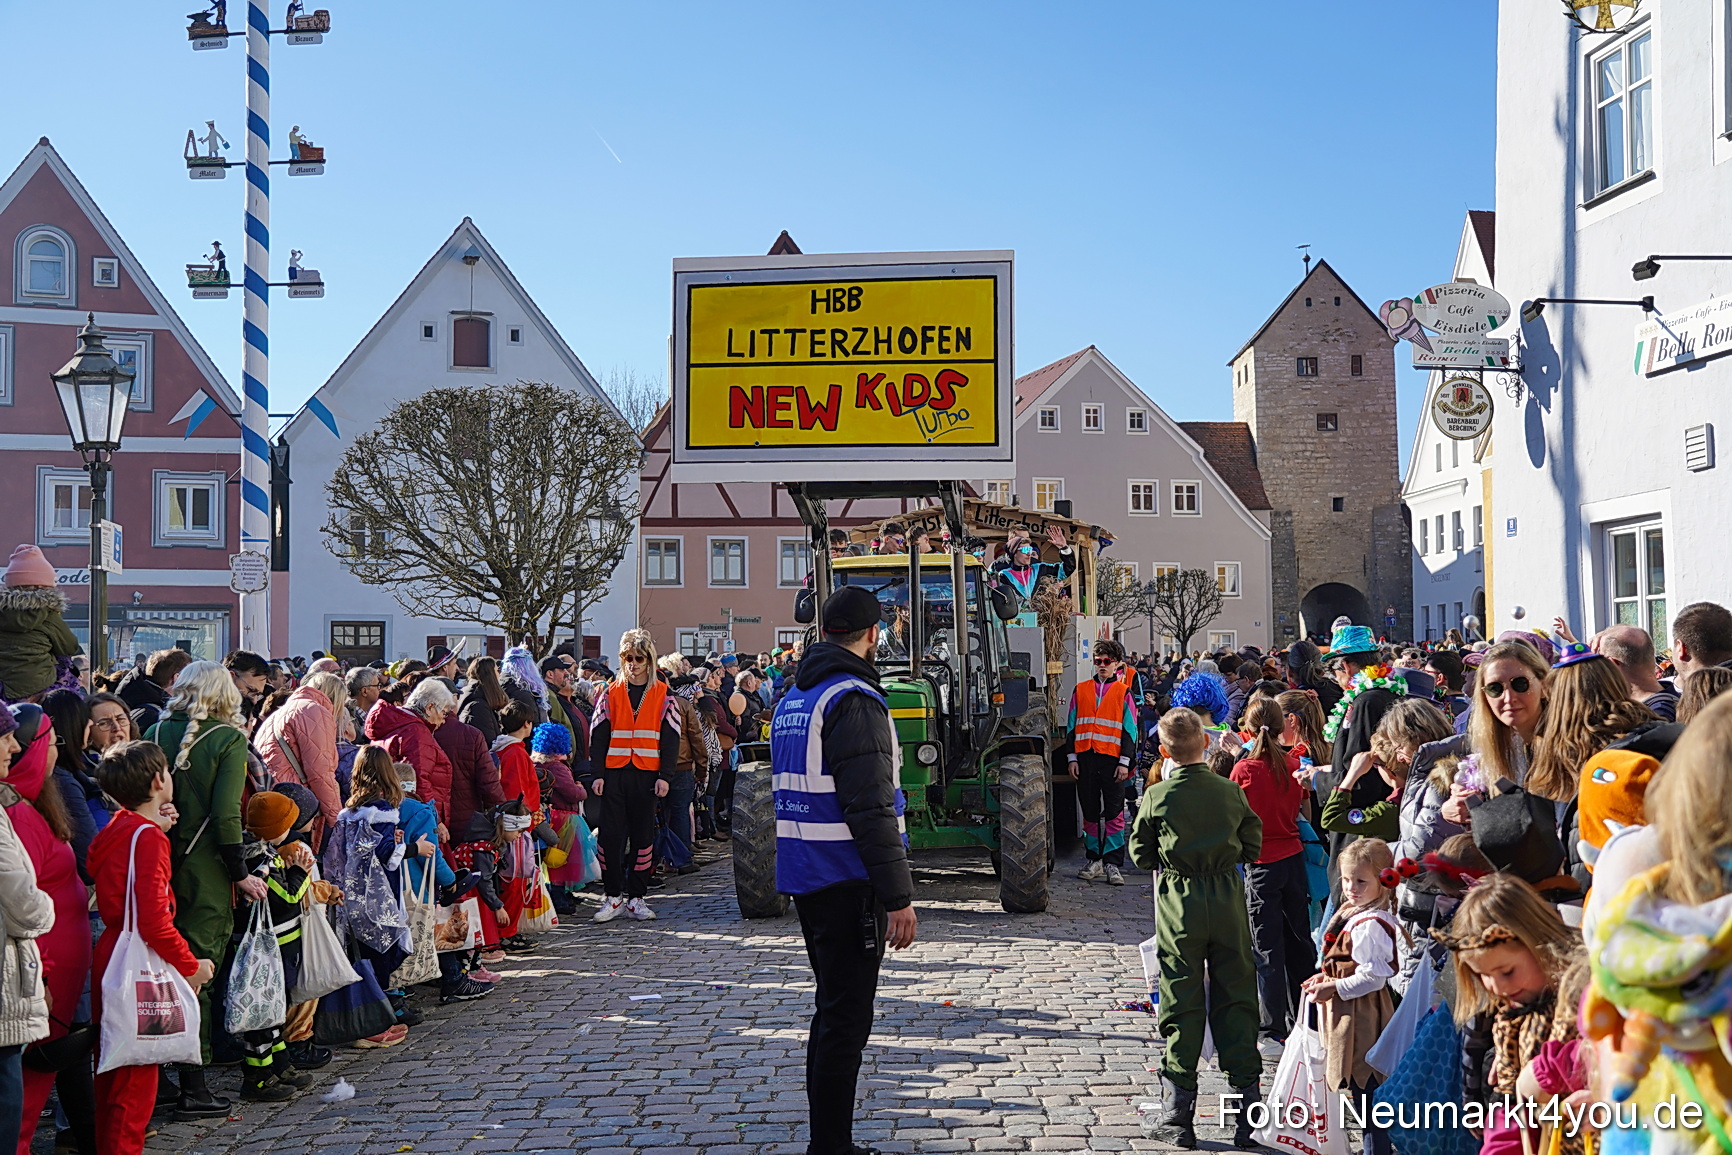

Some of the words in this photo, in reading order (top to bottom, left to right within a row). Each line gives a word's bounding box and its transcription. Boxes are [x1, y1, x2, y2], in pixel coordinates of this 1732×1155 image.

[811, 285, 864, 315] HBB
[1435, 287, 1485, 299] Pizzeria
[1447, 304, 1474, 316] Café
[1433, 319, 1487, 333] Eisdiele
[1661, 314, 1688, 329] Pizzeria
[726, 325, 972, 358] LITTERZHOFEN
[1656, 331, 1696, 362] Bella
[1443, 346, 1479, 354] Bella
[1418, 353, 1458, 362] Roma
[728, 384, 843, 432] NEW
[855, 369, 970, 417] KIDS
[785, 800, 809, 813] Service
